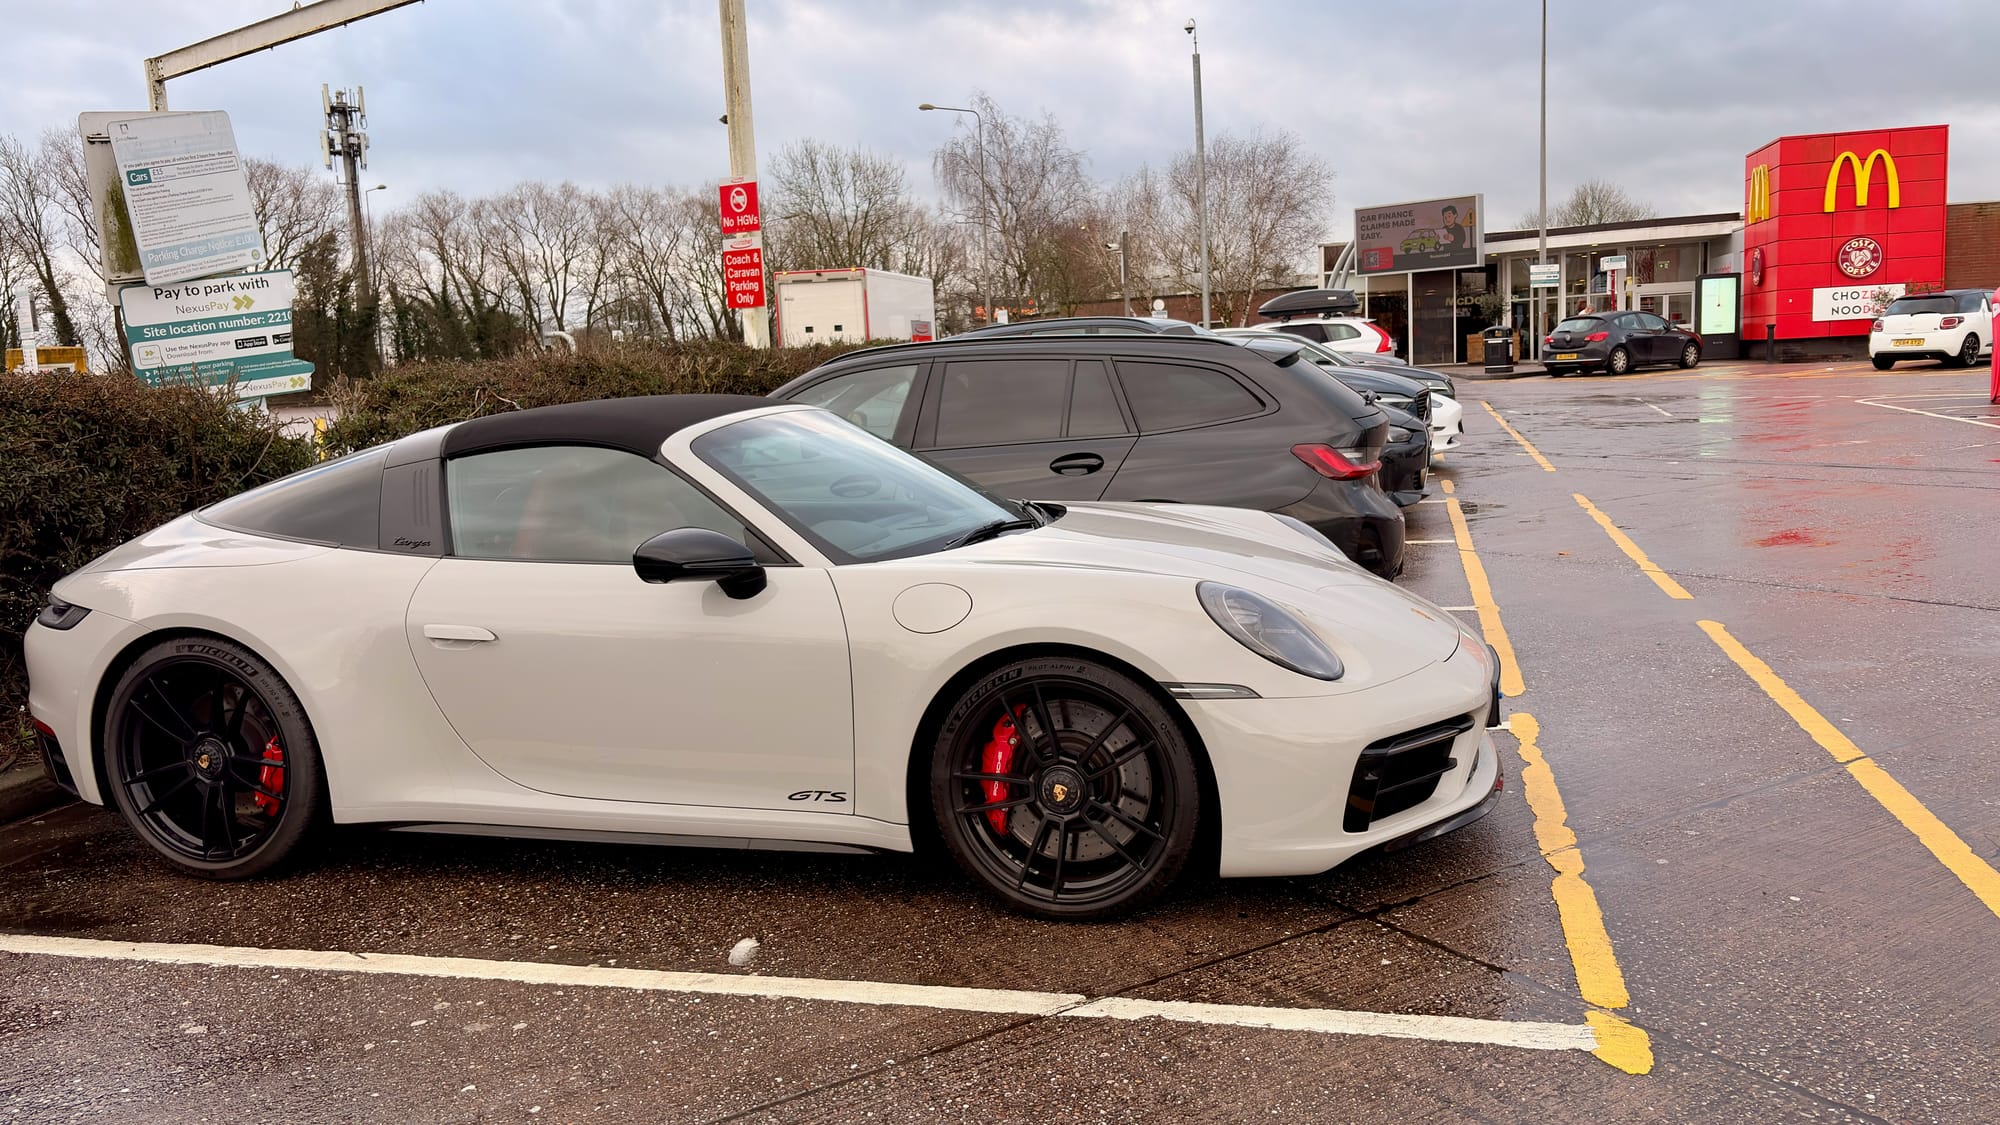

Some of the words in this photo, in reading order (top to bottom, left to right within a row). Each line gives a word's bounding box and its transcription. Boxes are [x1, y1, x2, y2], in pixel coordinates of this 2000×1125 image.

[130, 172, 148, 182] Cars
[723, 217, 734, 227] No
[737, 214, 758, 226] HGVs
[1361, 214, 1376, 222] CAR
[1378, 210, 1414, 221] FINANCE
[1360, 222, 1390, 232] CLAIMS
[1392, 218, 1415, 228] MADE
[148, 249, 179, 263] Parking
[180, 244, 208, 256] Charge
[208, 239, 234, 251] Notice:
[1845, 240, 1875, 252] COSTA
[726, 254, 751, 265] Coach
[753, 252, 759, 263] &
[728, 267, 760, 278] Caravan
[1843, 260, 1878, 274] COFFEE
[154, 288, 180, 300] Pay
[184, 284, 200, 296] to
[204, 279, 234, 297] park
[238, 277, 269, 291] with
[730, 280, 759, 292] Parking
[736, 293, 754, 305] Only
[176, 301, 229, 314] NexusPay
[144, 328, 166, 338] Site
[169, 322, 216, 335] location
[219, 316, 265, 329] number:
[247, 381, 287, 392] NexusPay
[192, 645, 256, 674] MICHELIN
[958, 668, 1019, 717] MICHELIN
[788, 790, 847, 802] GTS
